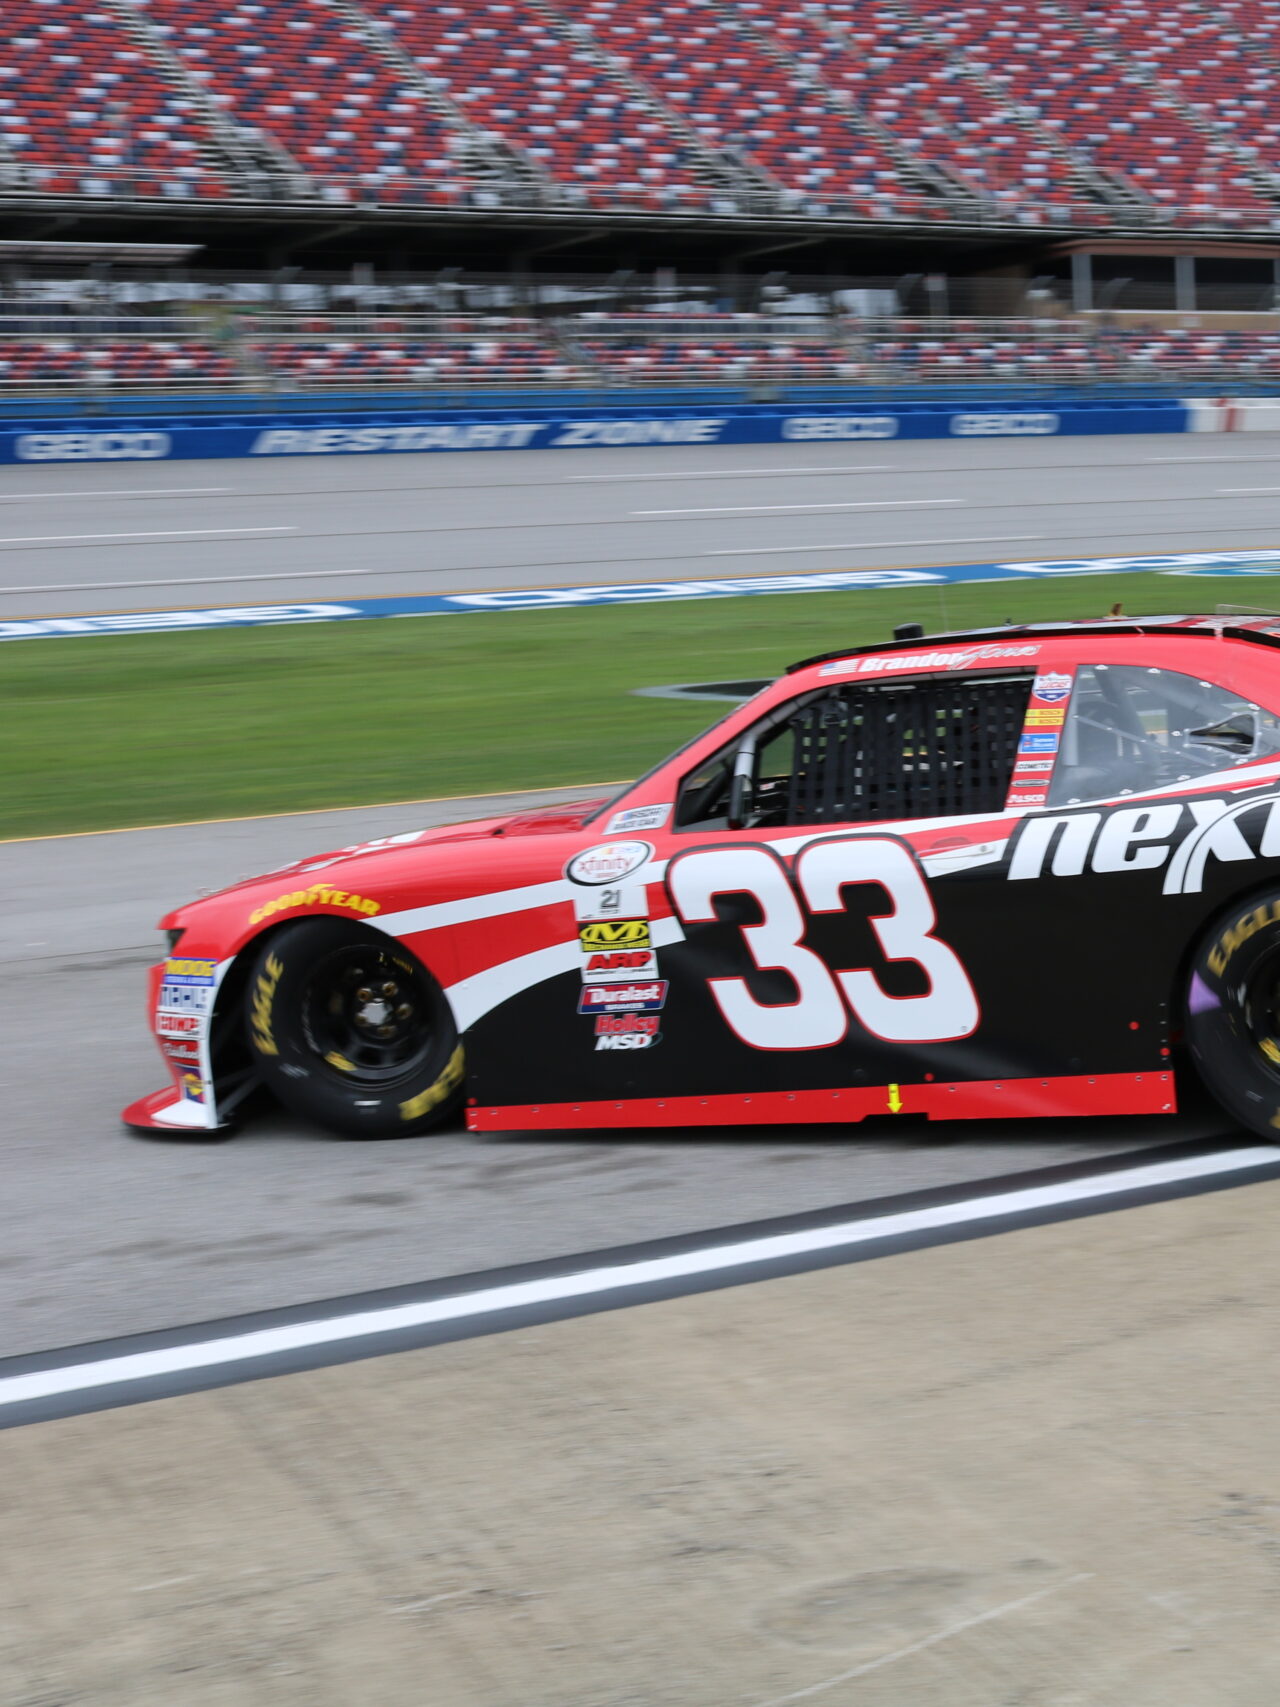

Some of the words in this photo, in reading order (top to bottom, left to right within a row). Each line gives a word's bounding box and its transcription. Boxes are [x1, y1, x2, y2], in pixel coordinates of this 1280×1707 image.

[782, 417, 898, 441] GEICO
[950, 413, 1059, 436] GEICO
[16, 432, 169, 459] GEICO
[249, 424, 548, 455] RESTART
[549, 419, 729, 447] ZONE
[667, 832, 981, 1051] 33
[587, 951, 652, 970] ARP
[587, 985, 660, 1003] Duralast
[595, 1034, 651, 1050] MSD
